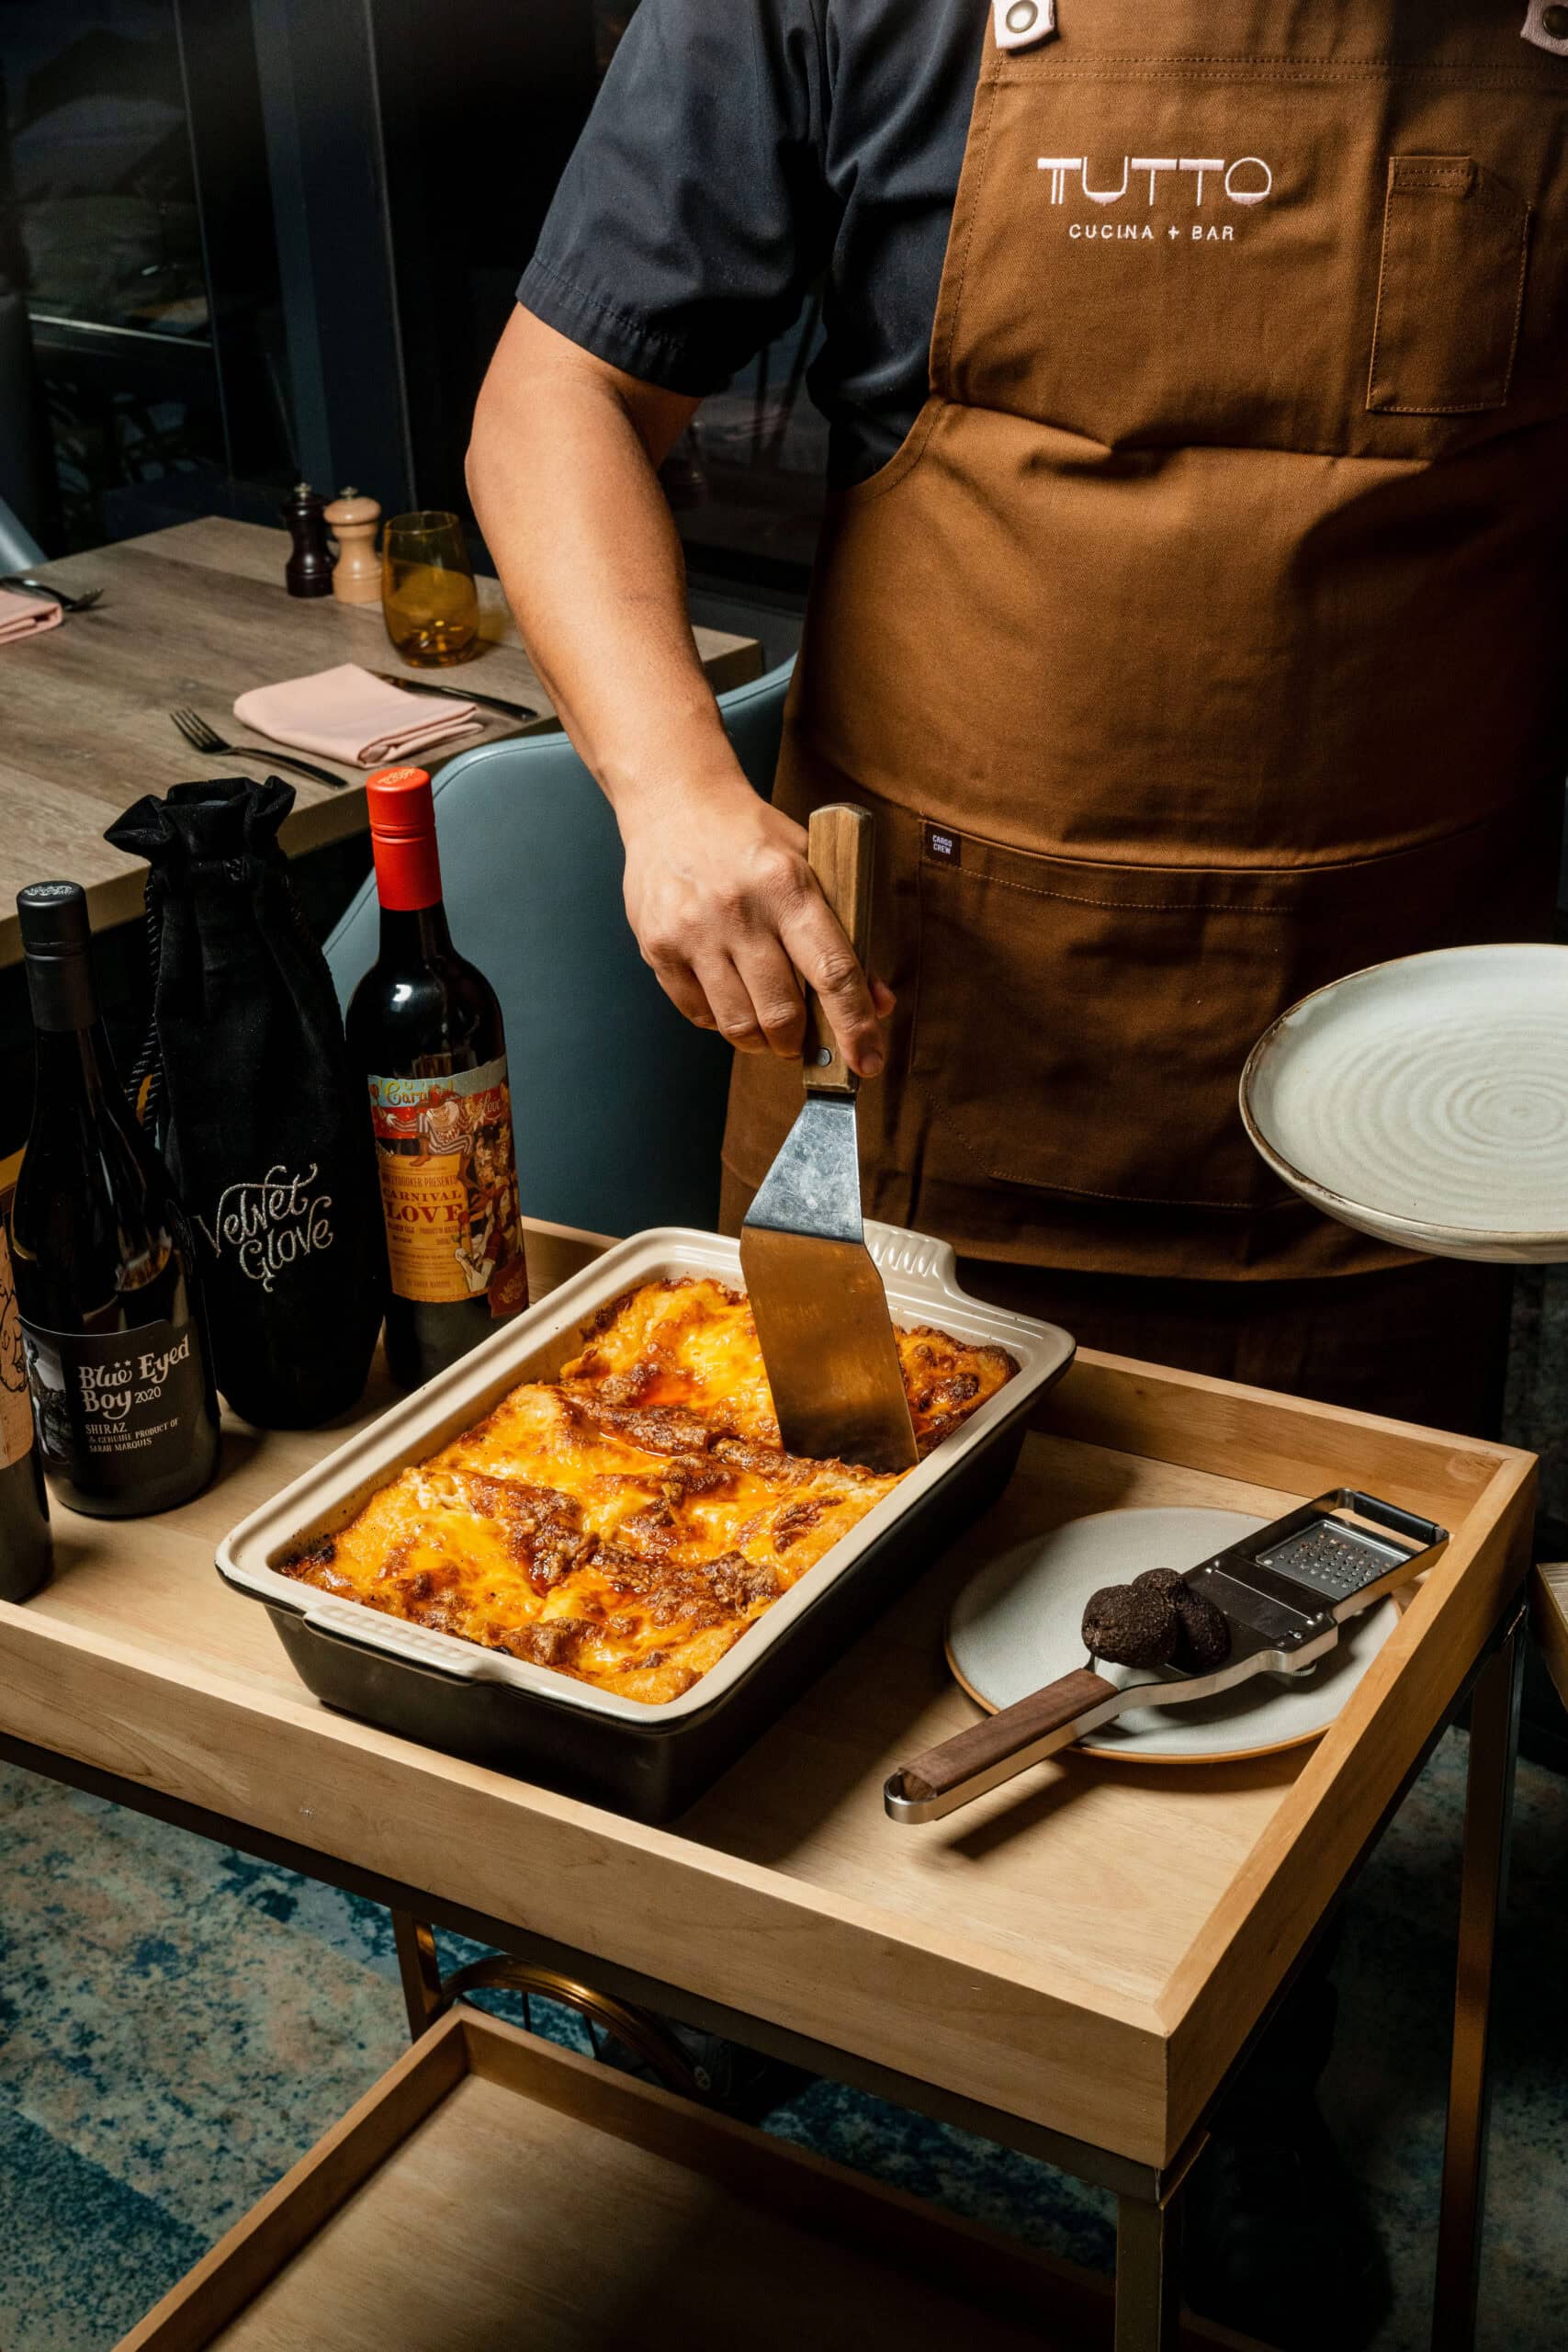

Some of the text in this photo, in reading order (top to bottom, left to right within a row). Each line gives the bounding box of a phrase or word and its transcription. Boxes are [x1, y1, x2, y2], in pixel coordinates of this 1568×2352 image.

[1037, 156, 1272, 207] TUTTO
[1068, 223, 1154, 240] CUCINA
[1191, 225, 1235, 241] BAR
[383, 1187, 462, 1202] CARNIVAL
[191, 1163, 318, 1259] Velvet
[386, 1201, 463, 1223] LOVE
[239, 1195, 333, 1293] Glove
[137, 1333, 190, 1384] Eyed
[81, 1385, 162, 1420] Boy 2020
[85, 1422, 127, 1434] SHIRAZ
[135, 1422, 168, 1440] PRODUCT
